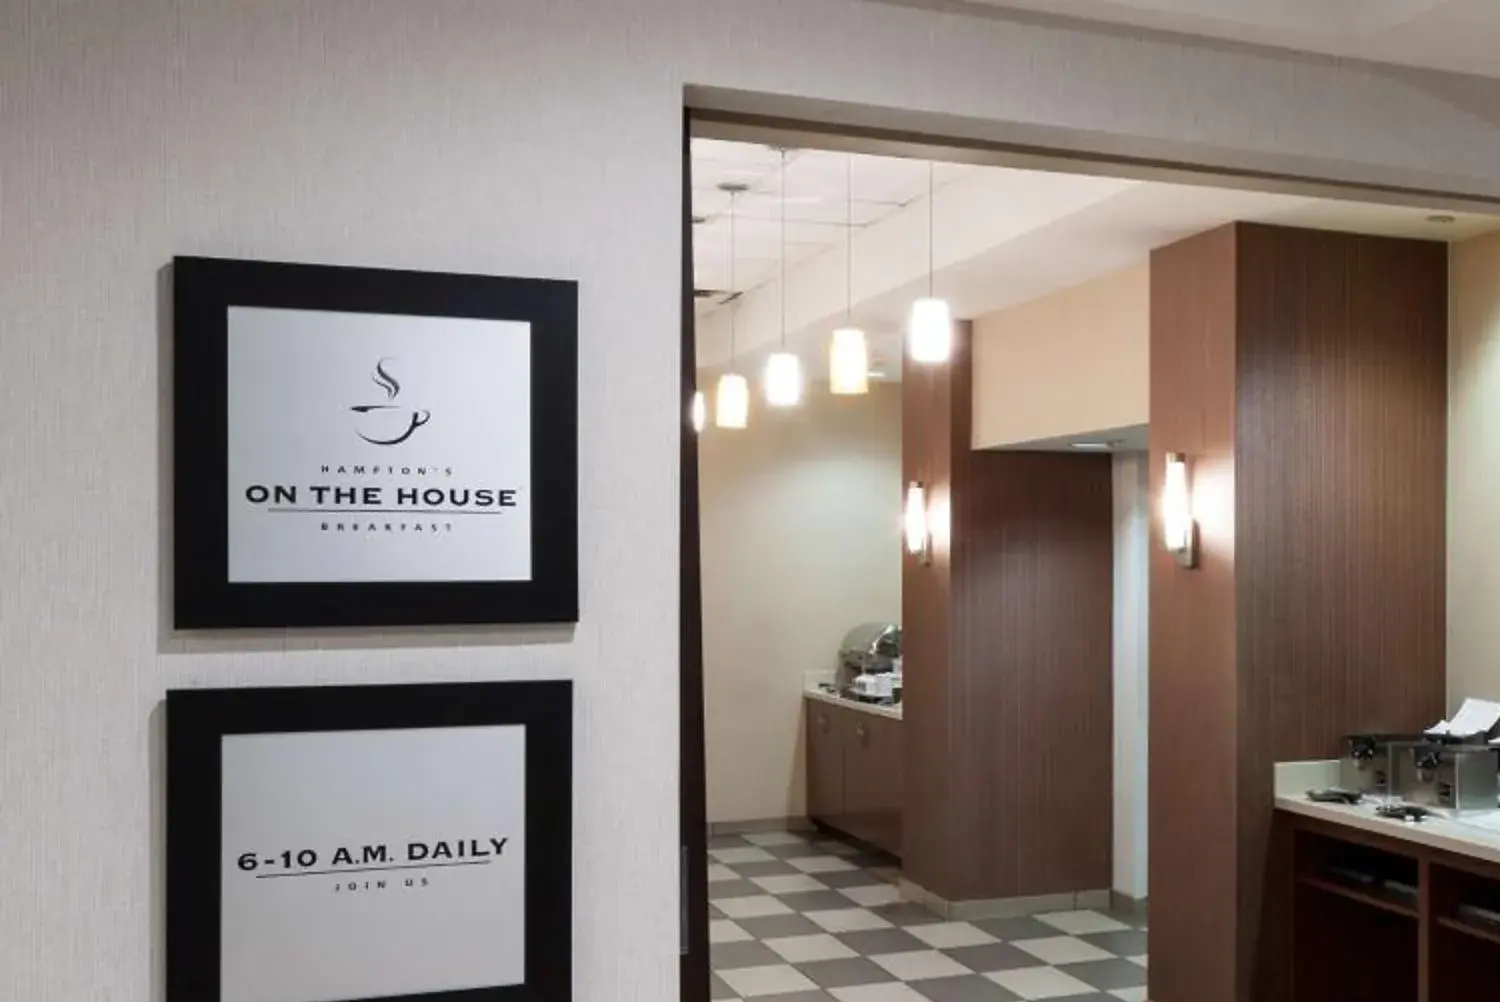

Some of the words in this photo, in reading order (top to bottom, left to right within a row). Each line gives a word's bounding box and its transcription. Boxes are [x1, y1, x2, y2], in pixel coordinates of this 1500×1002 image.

[245, 485, 297, 505] ON
[309, 486, 382, 506] THE
[397, 488, 517, 507] HOUSE
[320, 522, 452, 532] BREAKFAST
[237, 849, 318, 871] 6-10
[331, 844, 395, 866] A.M.
[407, 837, 508, 861] DAILY
[334, 880, 387, 892] JOIN
[404, 877, 429, 888] US
